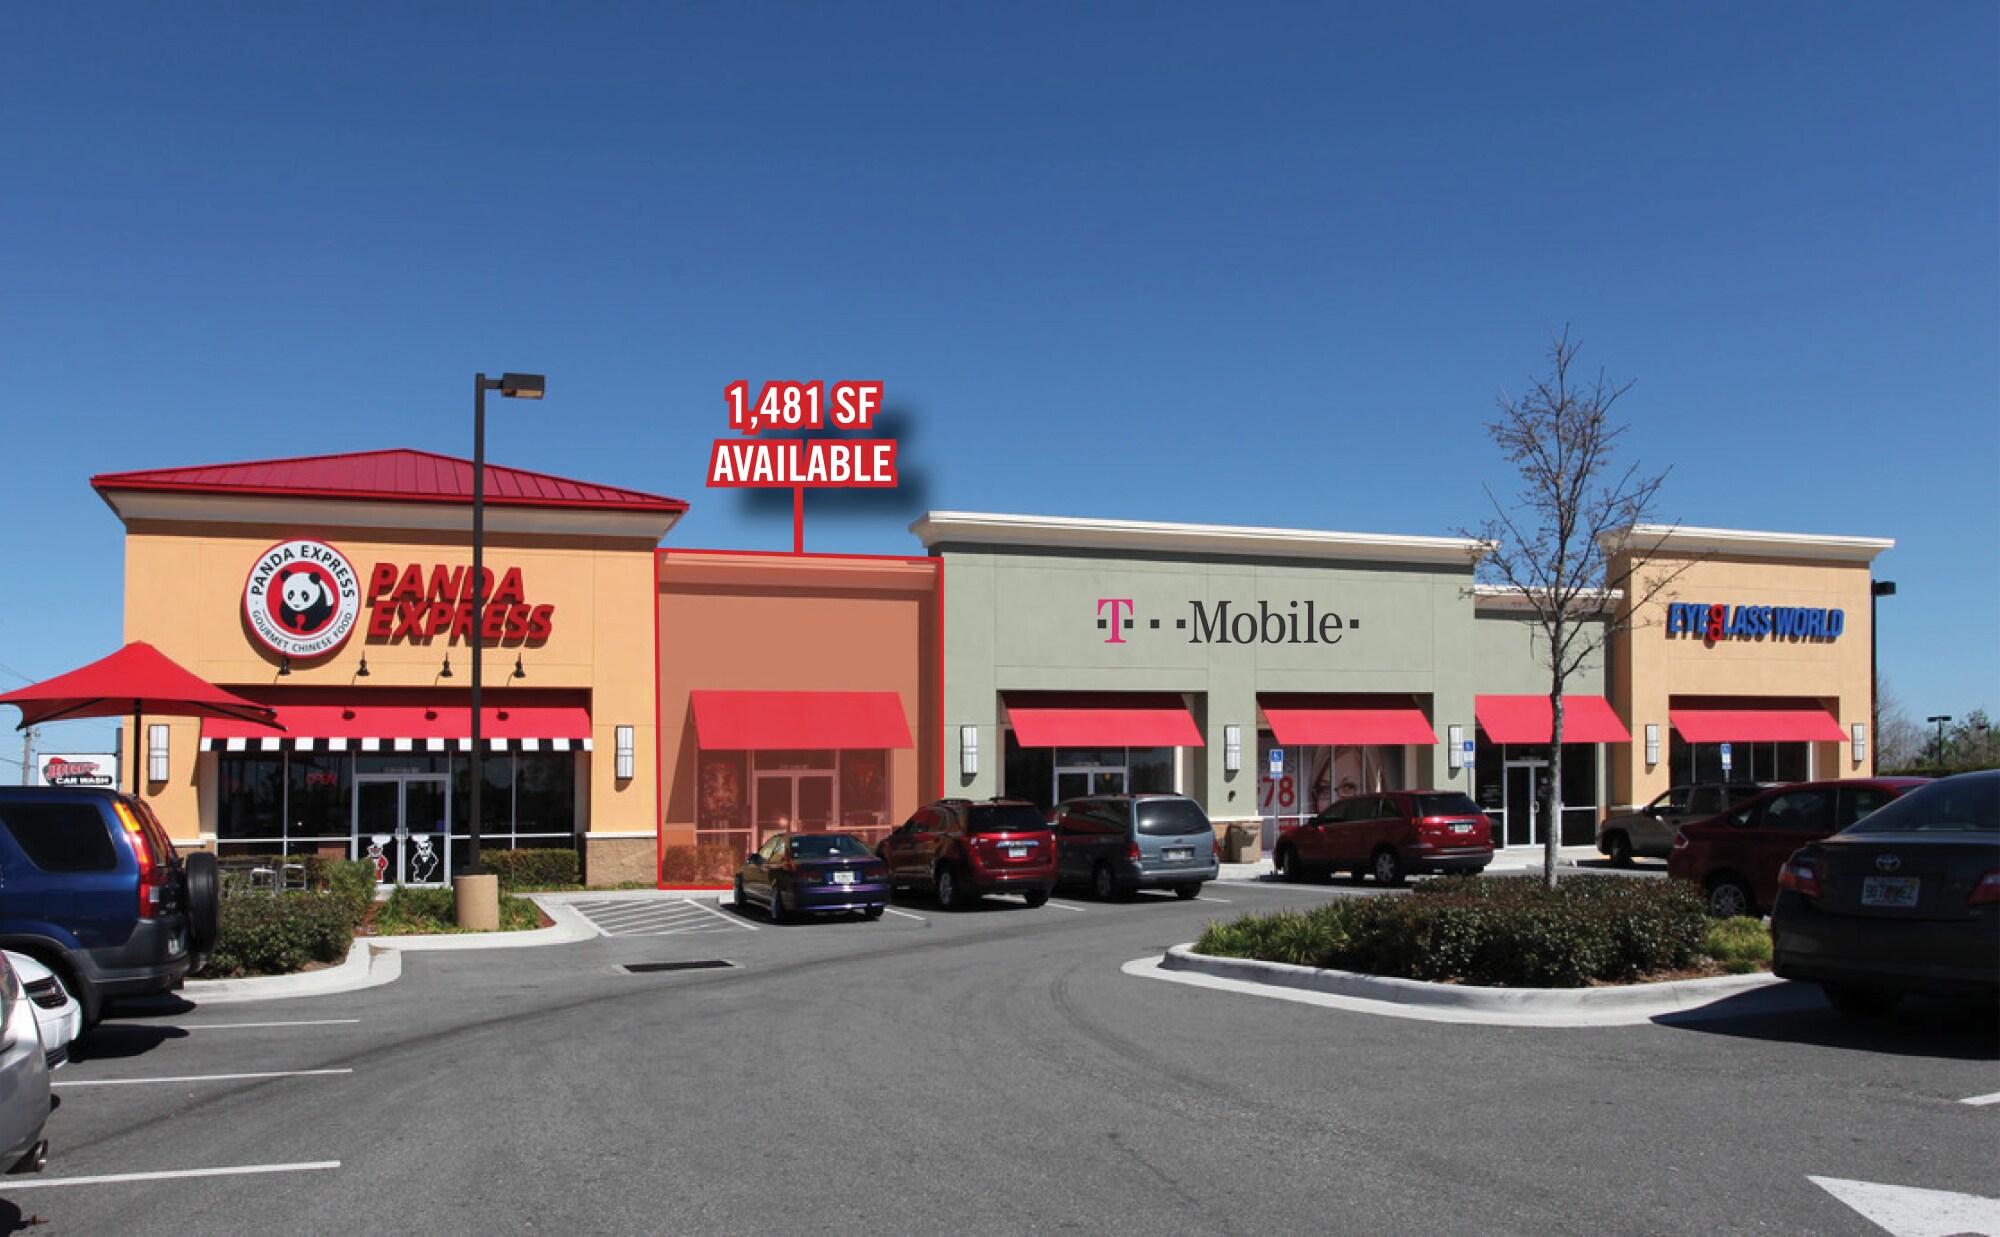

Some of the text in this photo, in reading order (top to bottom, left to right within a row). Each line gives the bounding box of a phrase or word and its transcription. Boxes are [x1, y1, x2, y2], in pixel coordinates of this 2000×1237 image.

[251, 544, 355, 598] PANDA EXPRESS
[367, 562, 524, 602] PANDA
[251, 609, 353, 653] GOURMET CHINESE FOOD
[367, 600, 556, 640] EXPRESS
[1775, 606, 1845, 637] WORLD
[57, 776, 110, 784] CAR WASH
[305, 773, 336, 785] OPEN
[1257, 775, 1295, 807] 78
